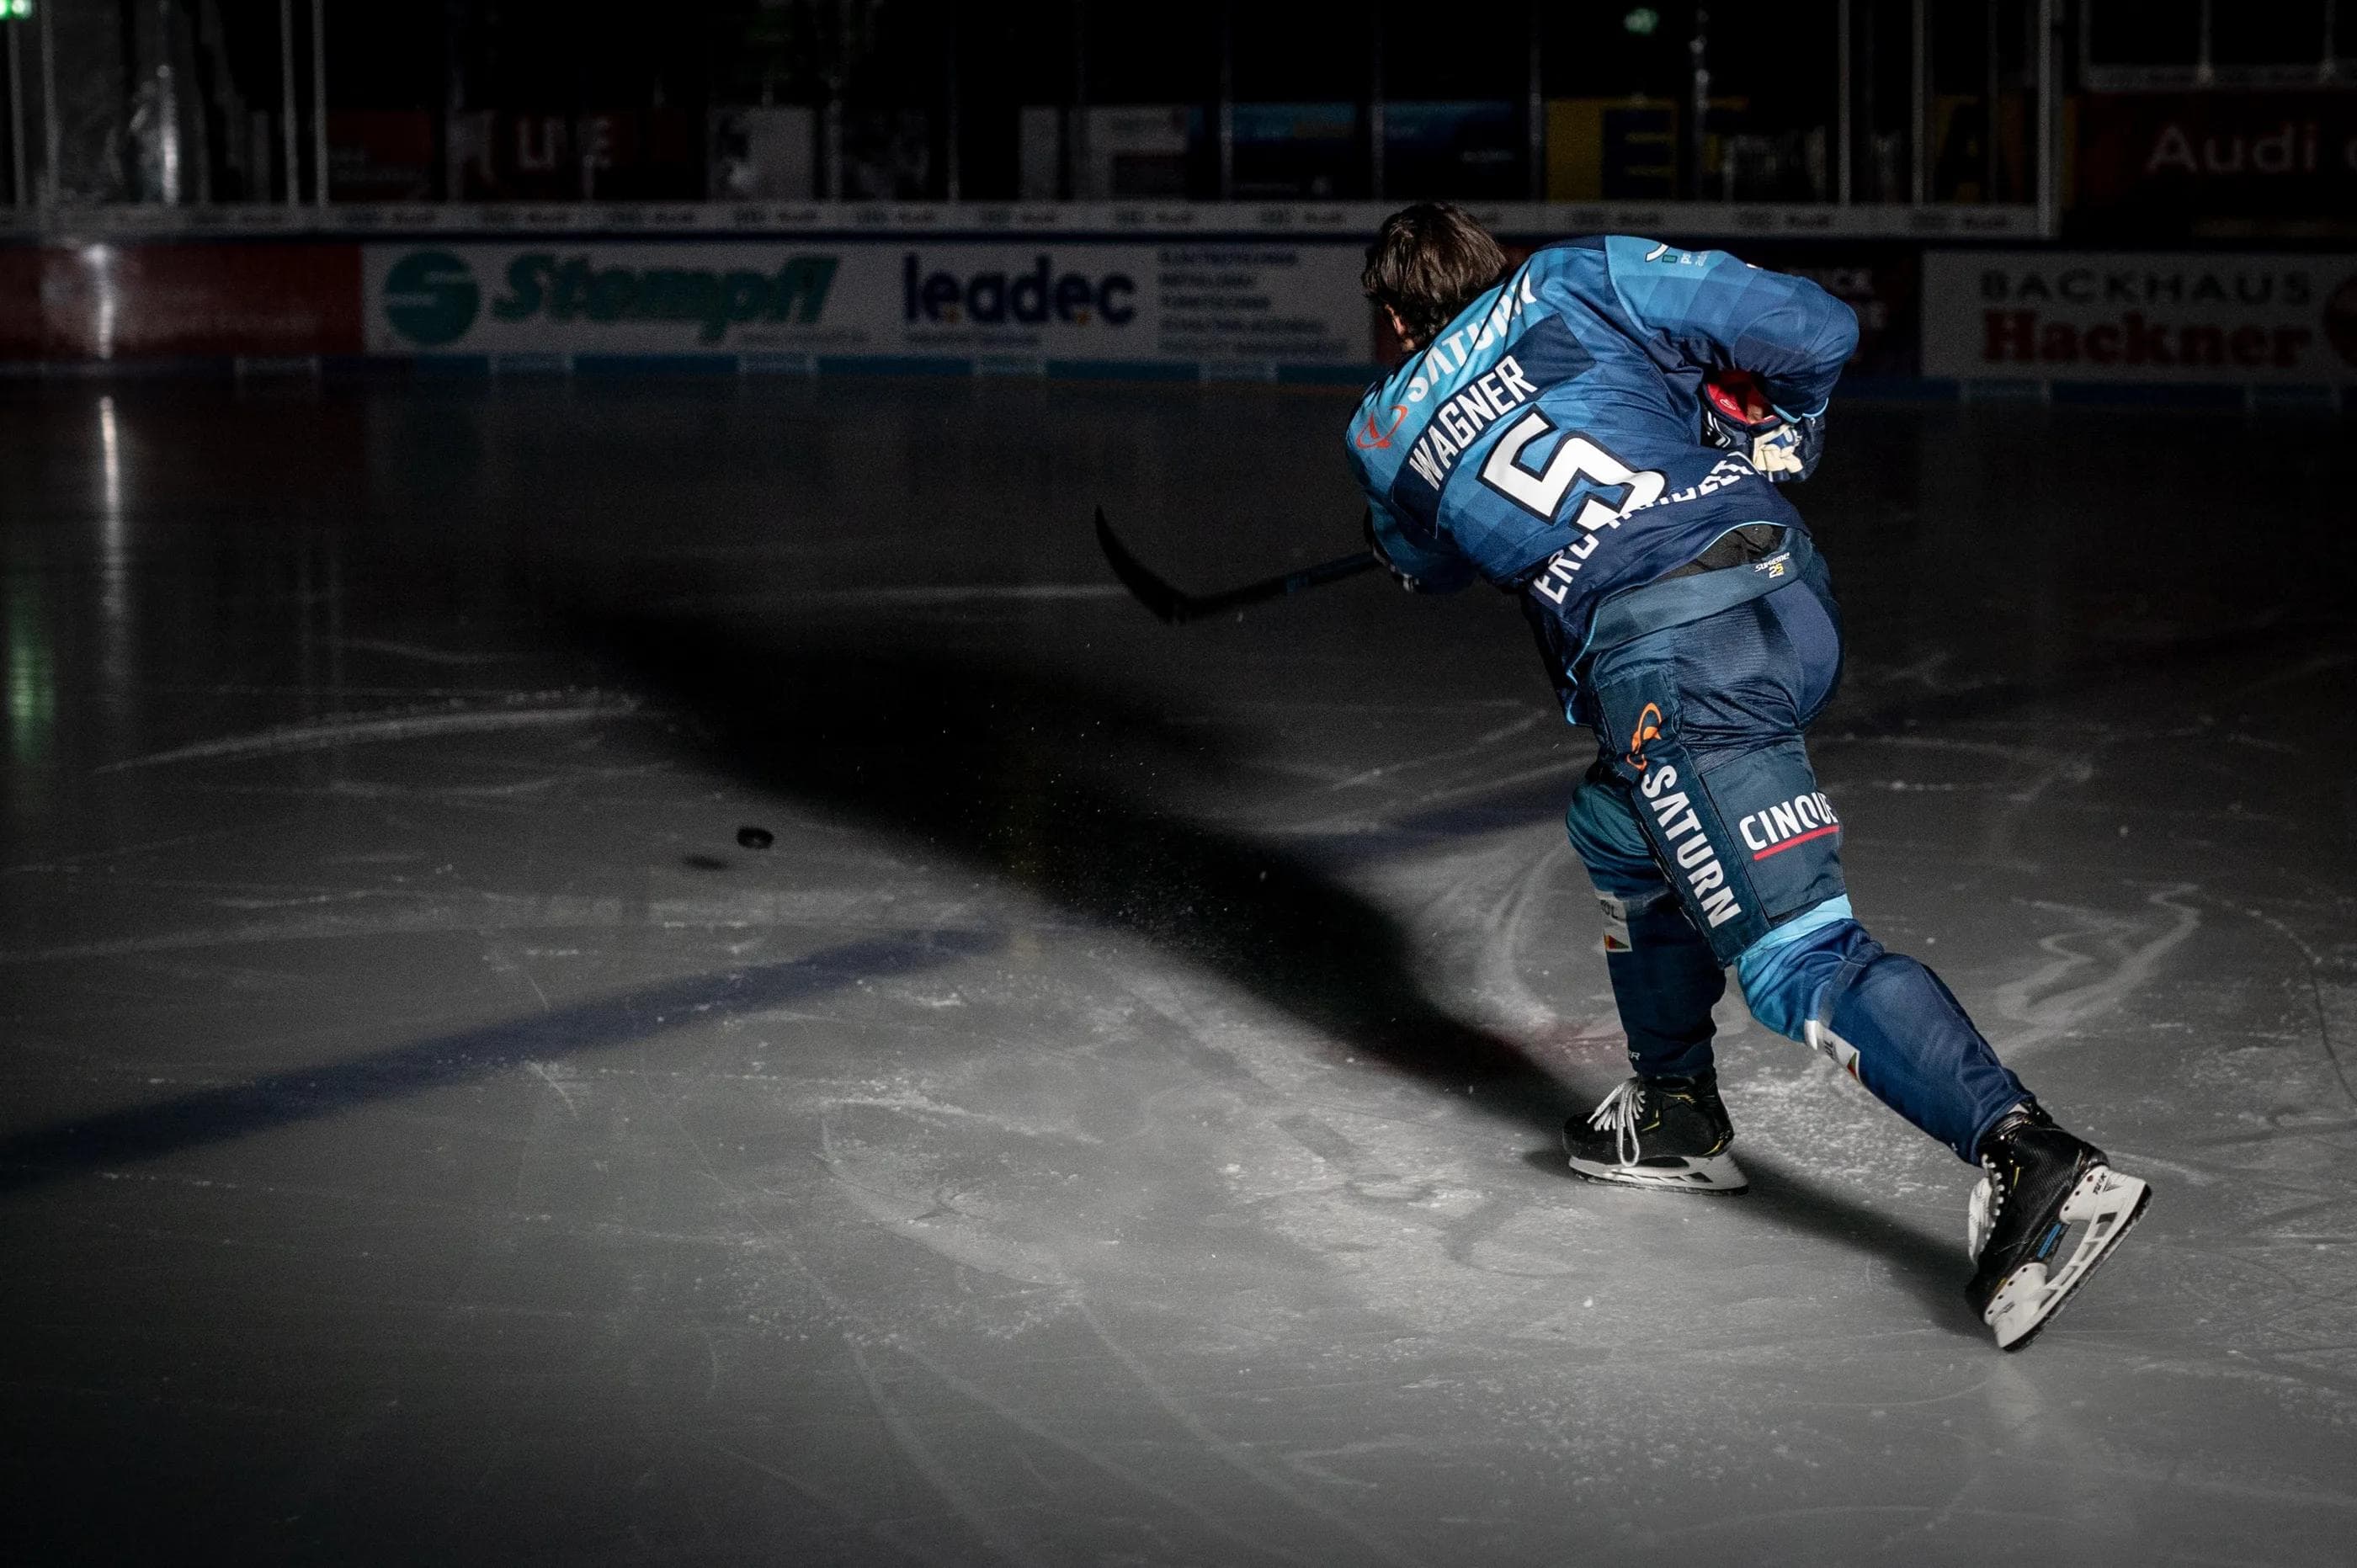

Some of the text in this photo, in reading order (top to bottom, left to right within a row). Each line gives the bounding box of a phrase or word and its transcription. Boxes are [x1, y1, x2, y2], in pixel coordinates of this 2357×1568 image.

[2143, 116, 2318, 175] Audi
[905, 253, 1134, 325] leadec
[1981, 268, 2312, 306] BACKHAUS
[1982, 308, 2312, 367] Hackner
[1407, 354, 1538, 493] WAGNER
[1476, 403, 1669, 535] 5
[1640, 764, 1742, 929] SATURN
